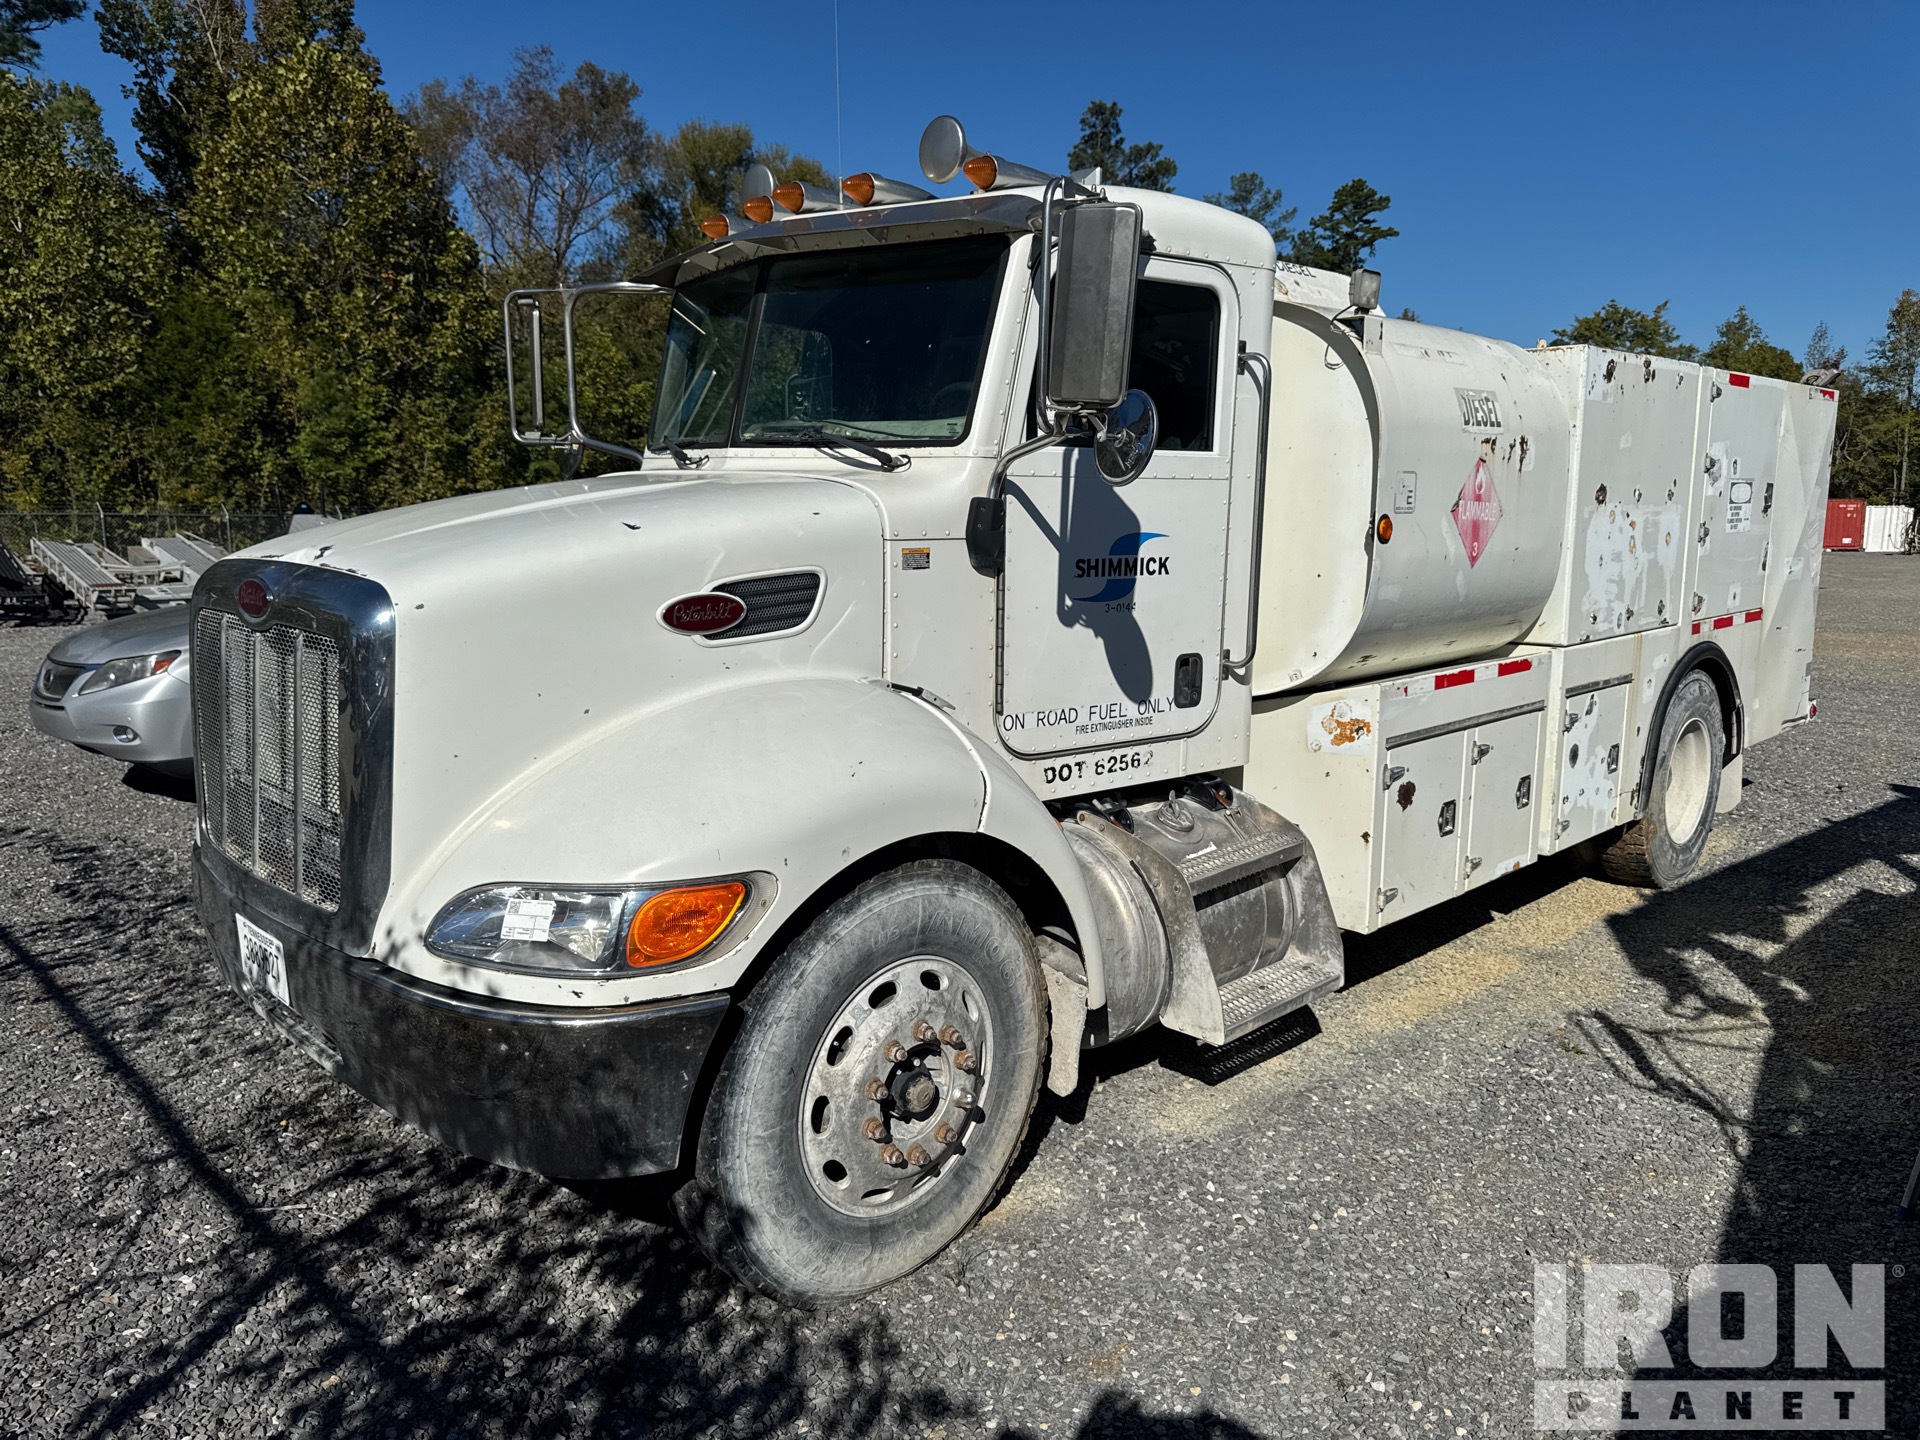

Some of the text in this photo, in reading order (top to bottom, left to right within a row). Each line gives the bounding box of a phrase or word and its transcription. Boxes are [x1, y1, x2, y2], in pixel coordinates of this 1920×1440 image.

[1461, 394, 1502, 427] DIESEL
[1458, 500, 1498, 520] FLAMMABLE
[1472, 541, 1478, 556] 3
[1074, 556, 1170, 579] SHIMMICK
[673, 602, 737, 625] Peterbilt
[1003, 697, 1174, 732] ON ROAD FUEL ONLY
[1075, 716, 1153, 735] FIRE EXTINGUISHER INSIDE
[1044, 761, 1087, 784] DOT
